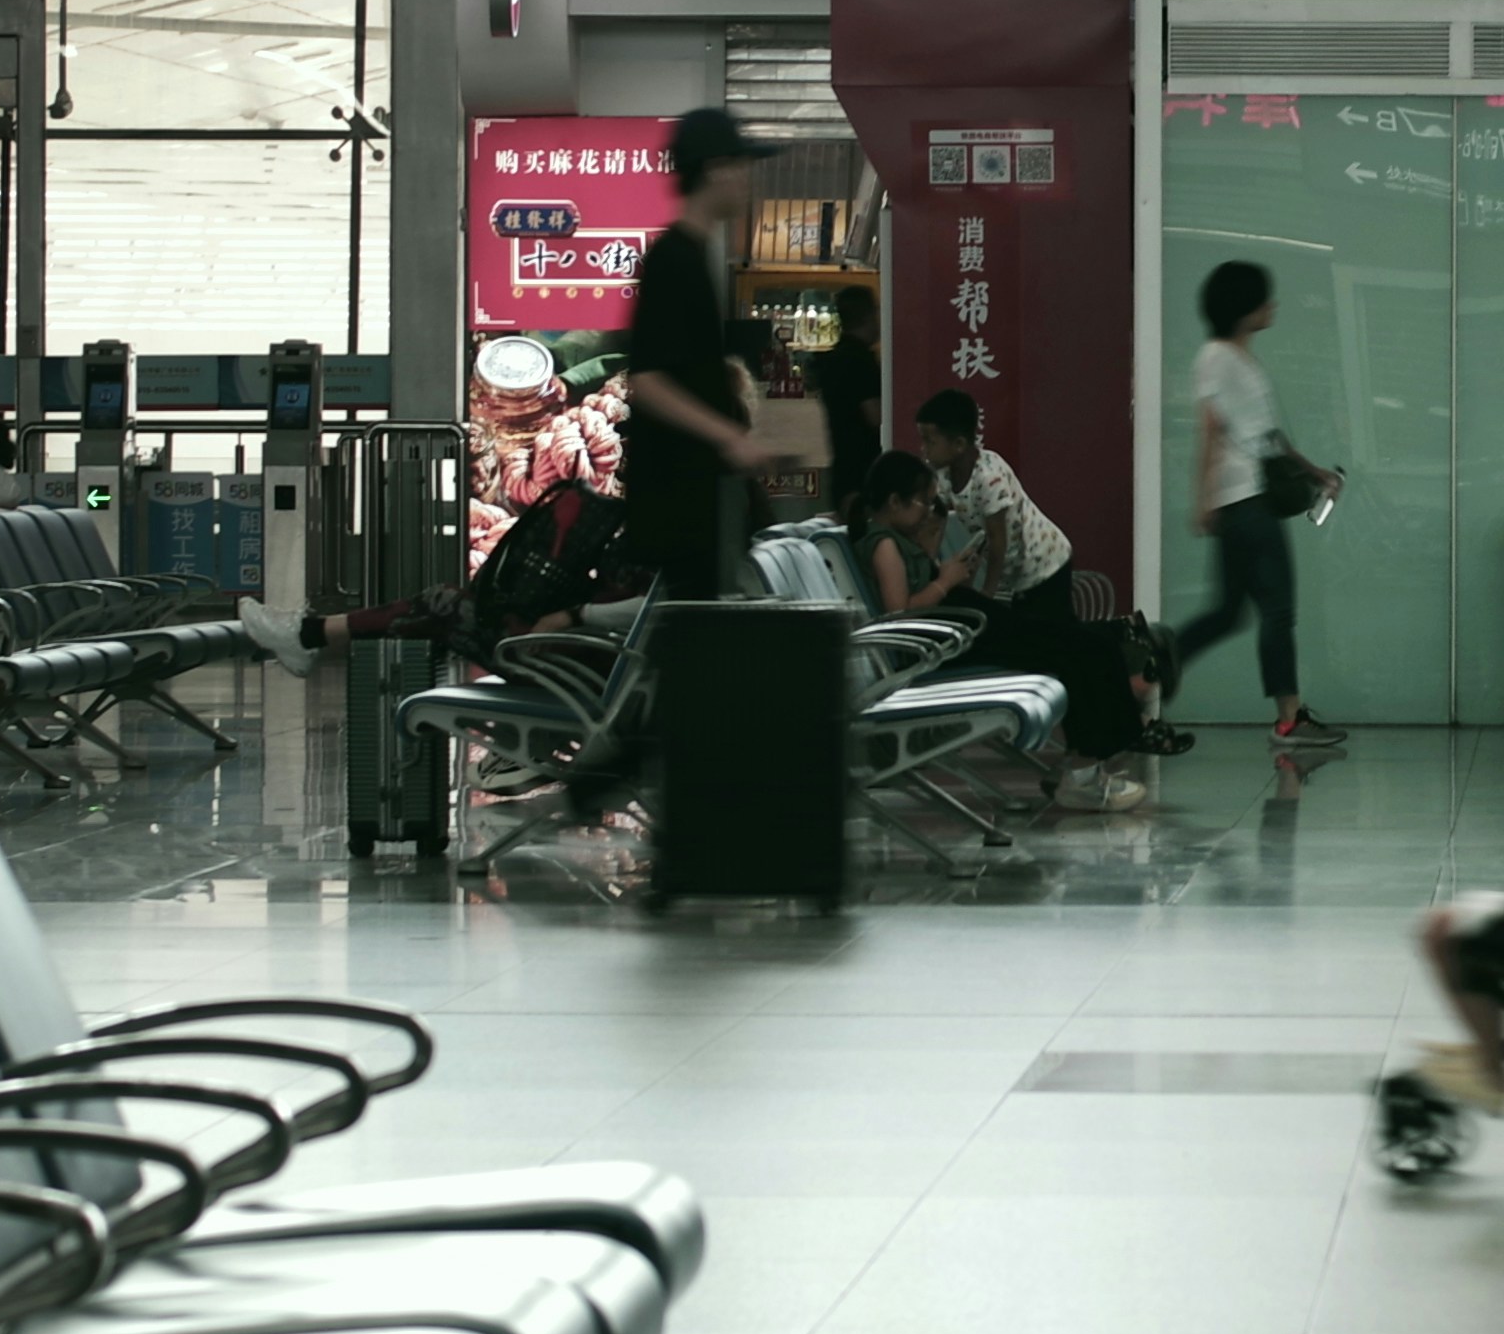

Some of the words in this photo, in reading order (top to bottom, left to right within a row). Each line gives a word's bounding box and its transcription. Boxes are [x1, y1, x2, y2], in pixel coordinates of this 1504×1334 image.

[520, 238, 644, 278] 十八街
[950, 216, 1001, 380] 消费帮扶
[154, 480, 205, 498] 58同城
